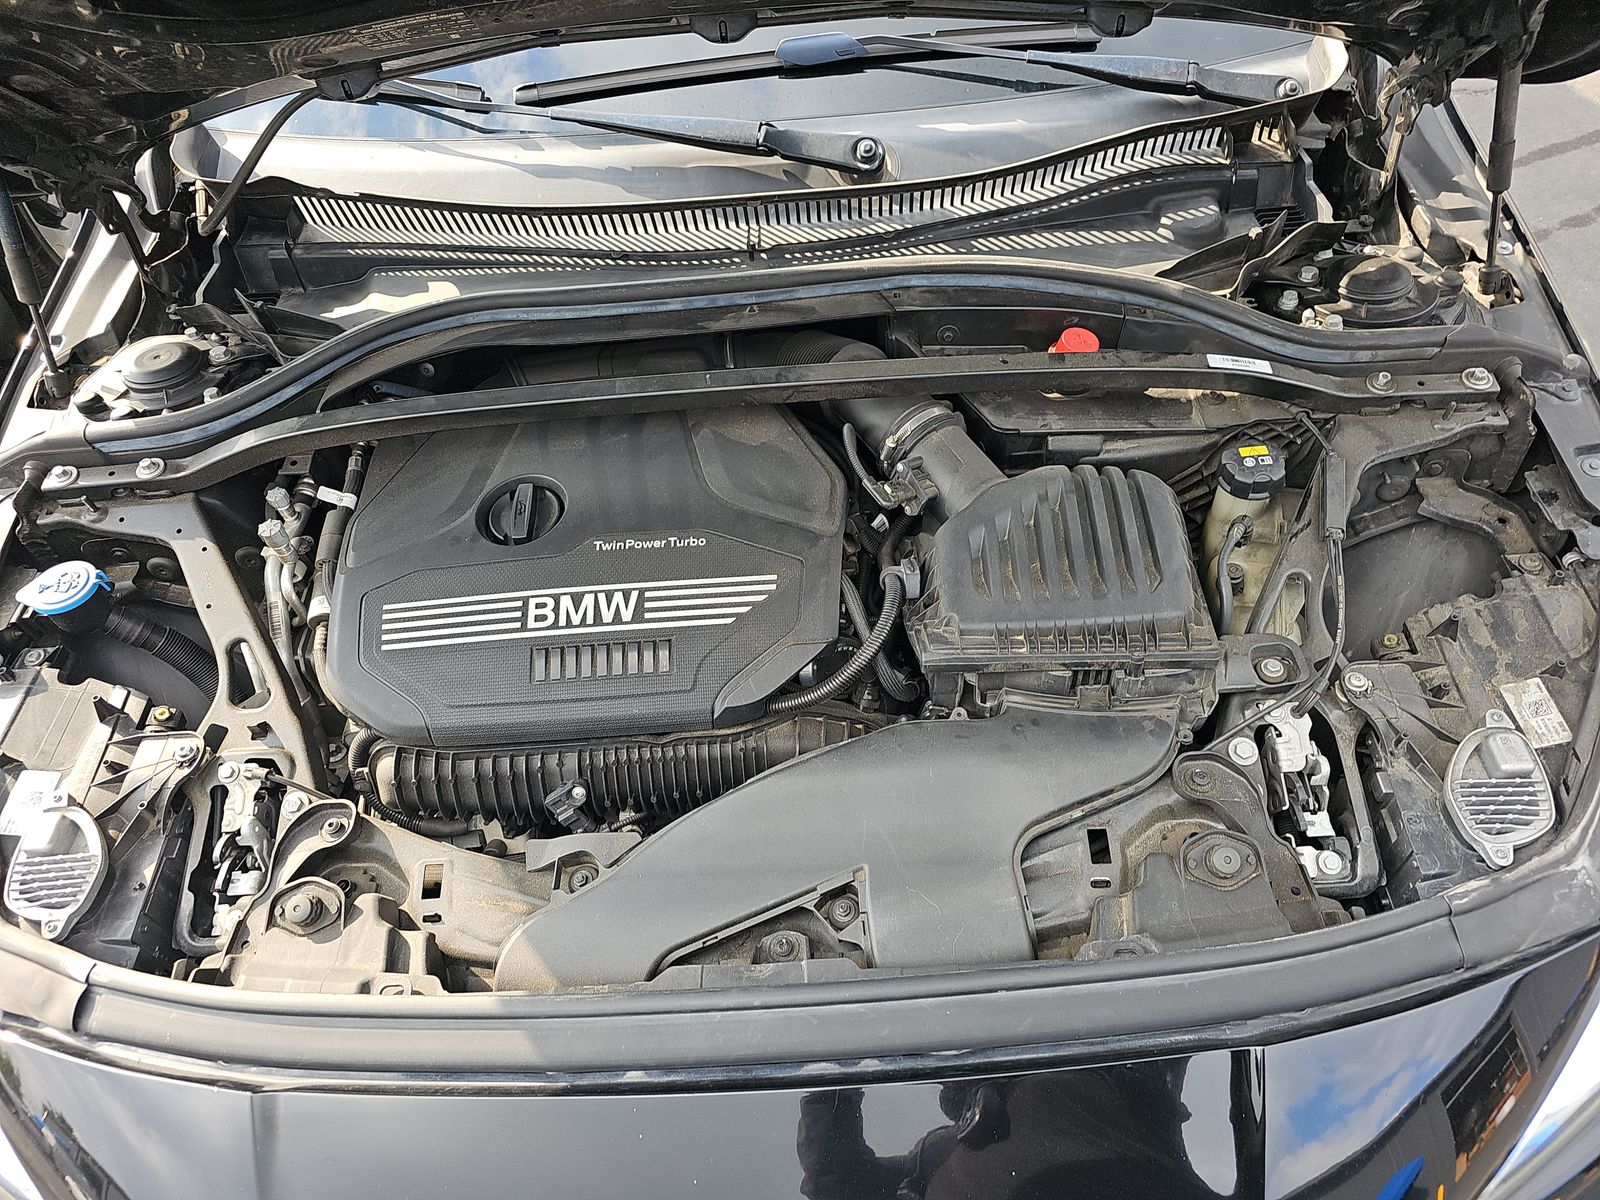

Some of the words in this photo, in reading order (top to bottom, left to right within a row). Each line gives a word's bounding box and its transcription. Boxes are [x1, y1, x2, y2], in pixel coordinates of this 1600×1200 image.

[593, 539, 667, 552] TwinPower
[668, 536, 707, 548] Turbo
[526, 590, 640, 629] BMW
